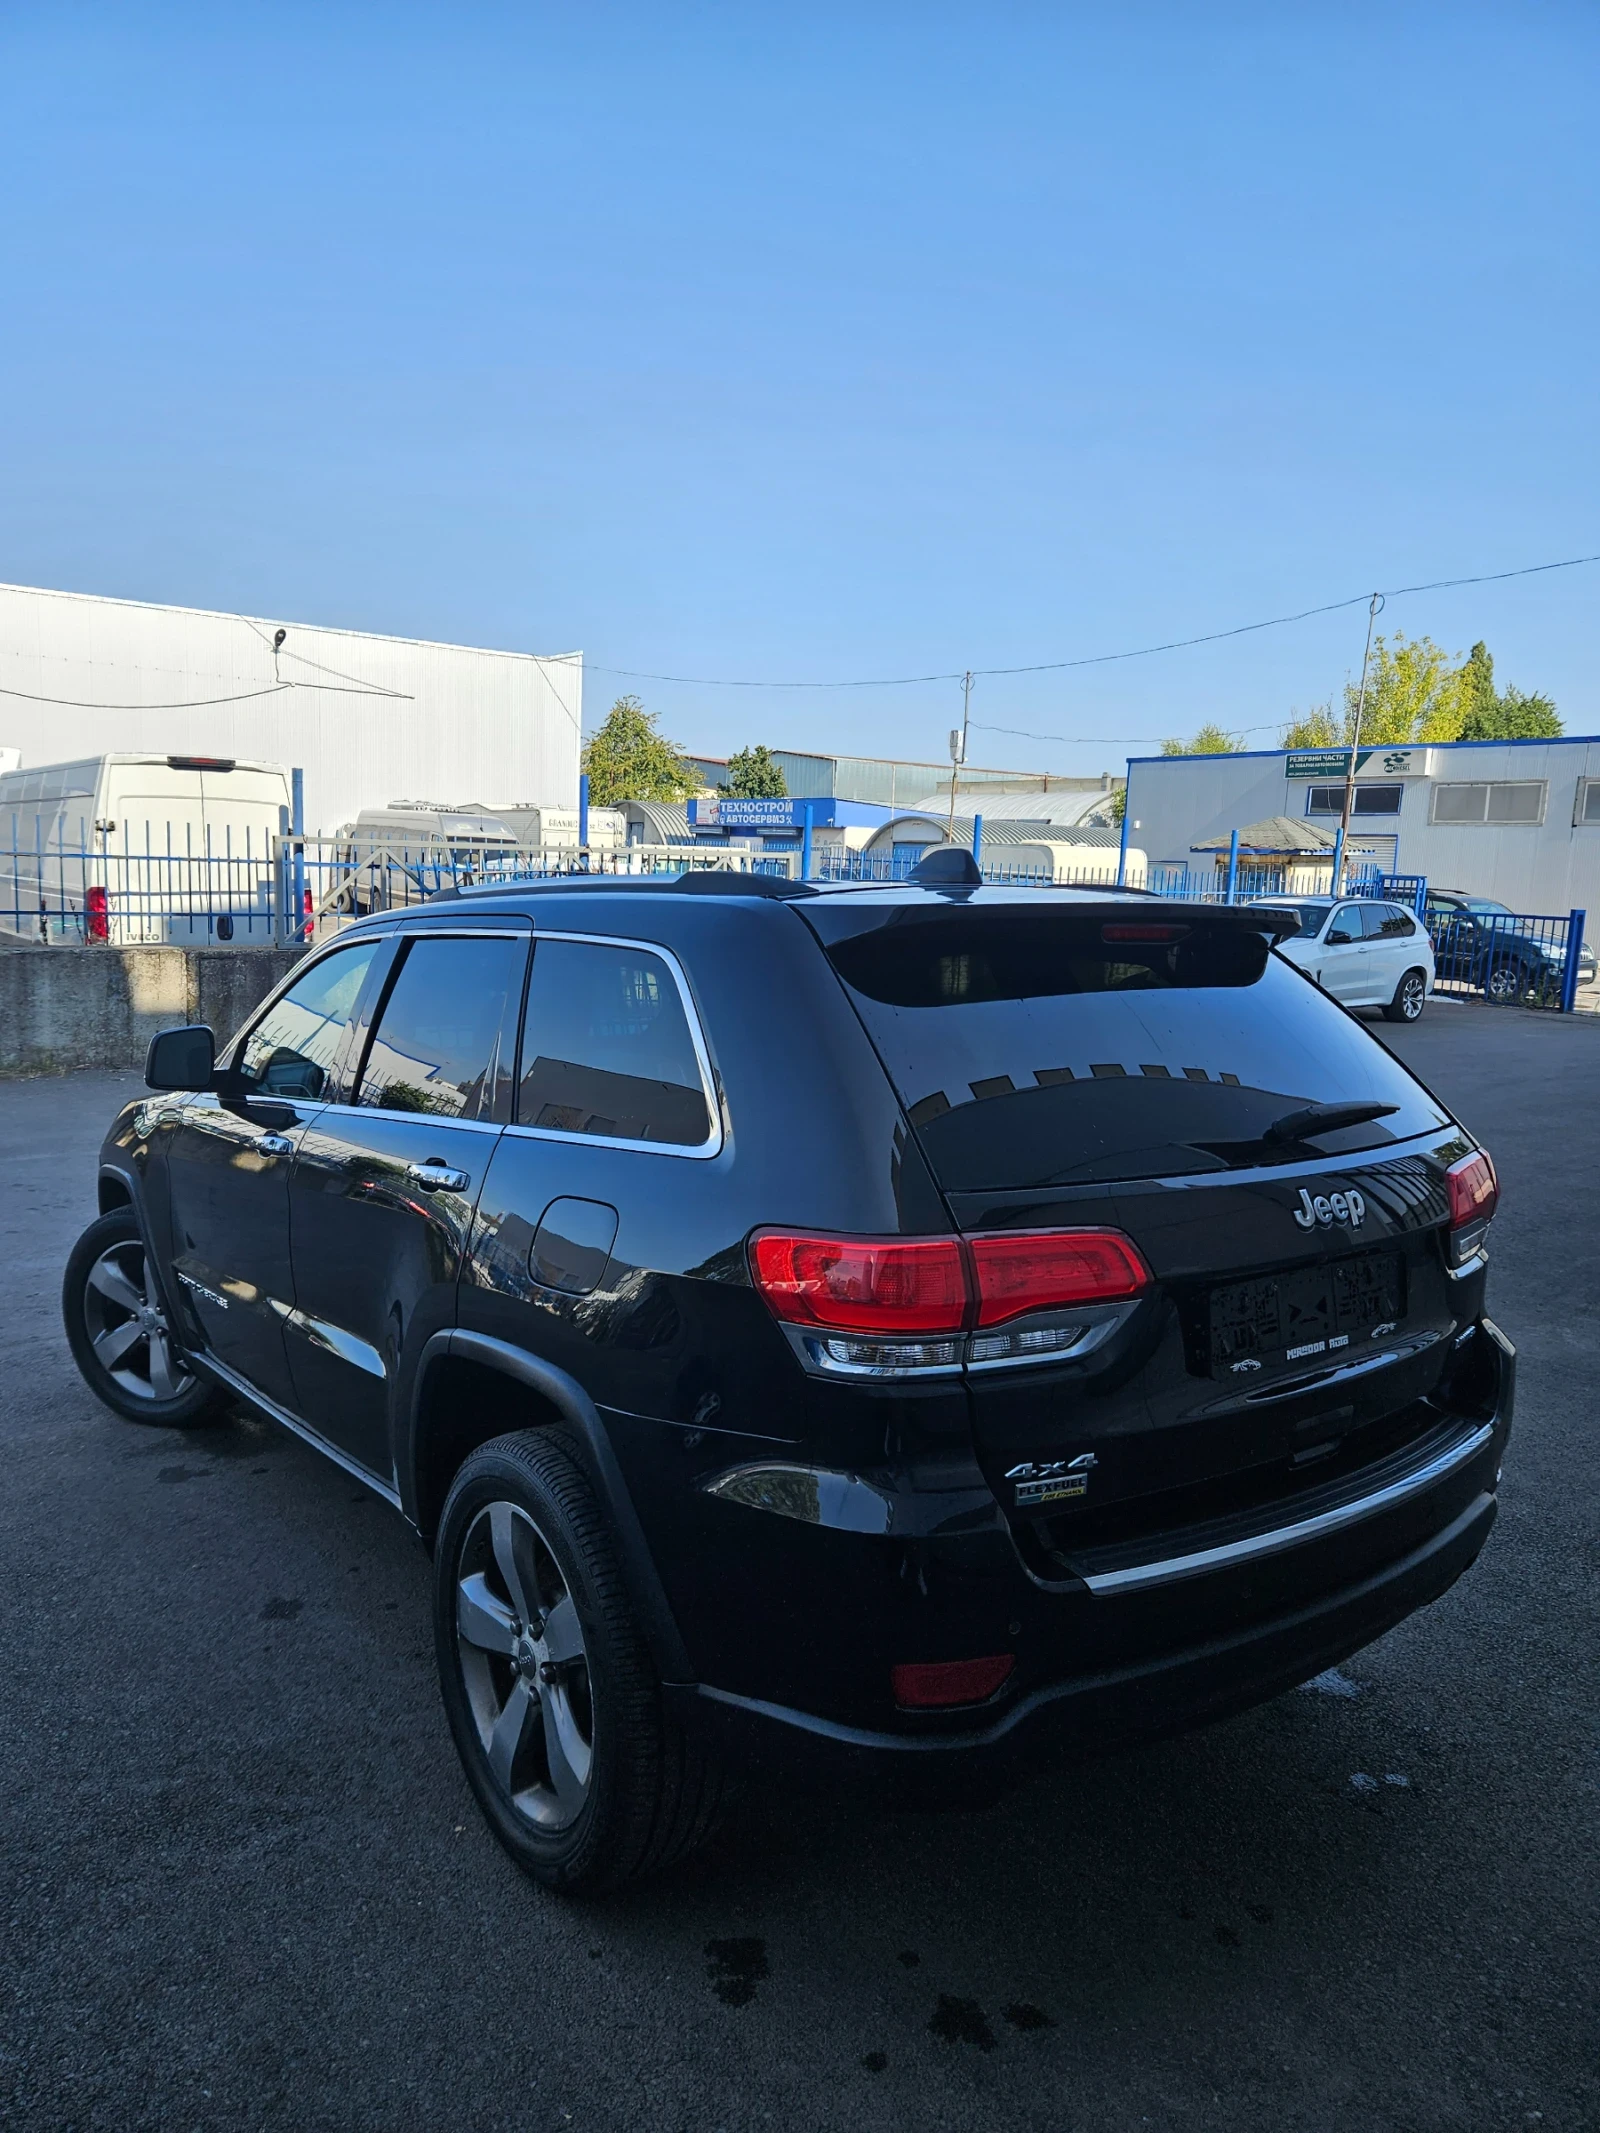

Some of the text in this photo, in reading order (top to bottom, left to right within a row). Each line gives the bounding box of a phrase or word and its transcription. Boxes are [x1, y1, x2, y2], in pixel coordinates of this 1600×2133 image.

[1289, 755, 1322, 763] РЕЗЕРВНИ
[720, 800, 794, 813] ТЕХНОСТРОЙ
[726, 814, 785, 824] АВТОСЕРВИЗ
[1293, 1188, 1366, 1227] Jeep
[1017, 1477, 1087, 1497] FLEXFUEL
